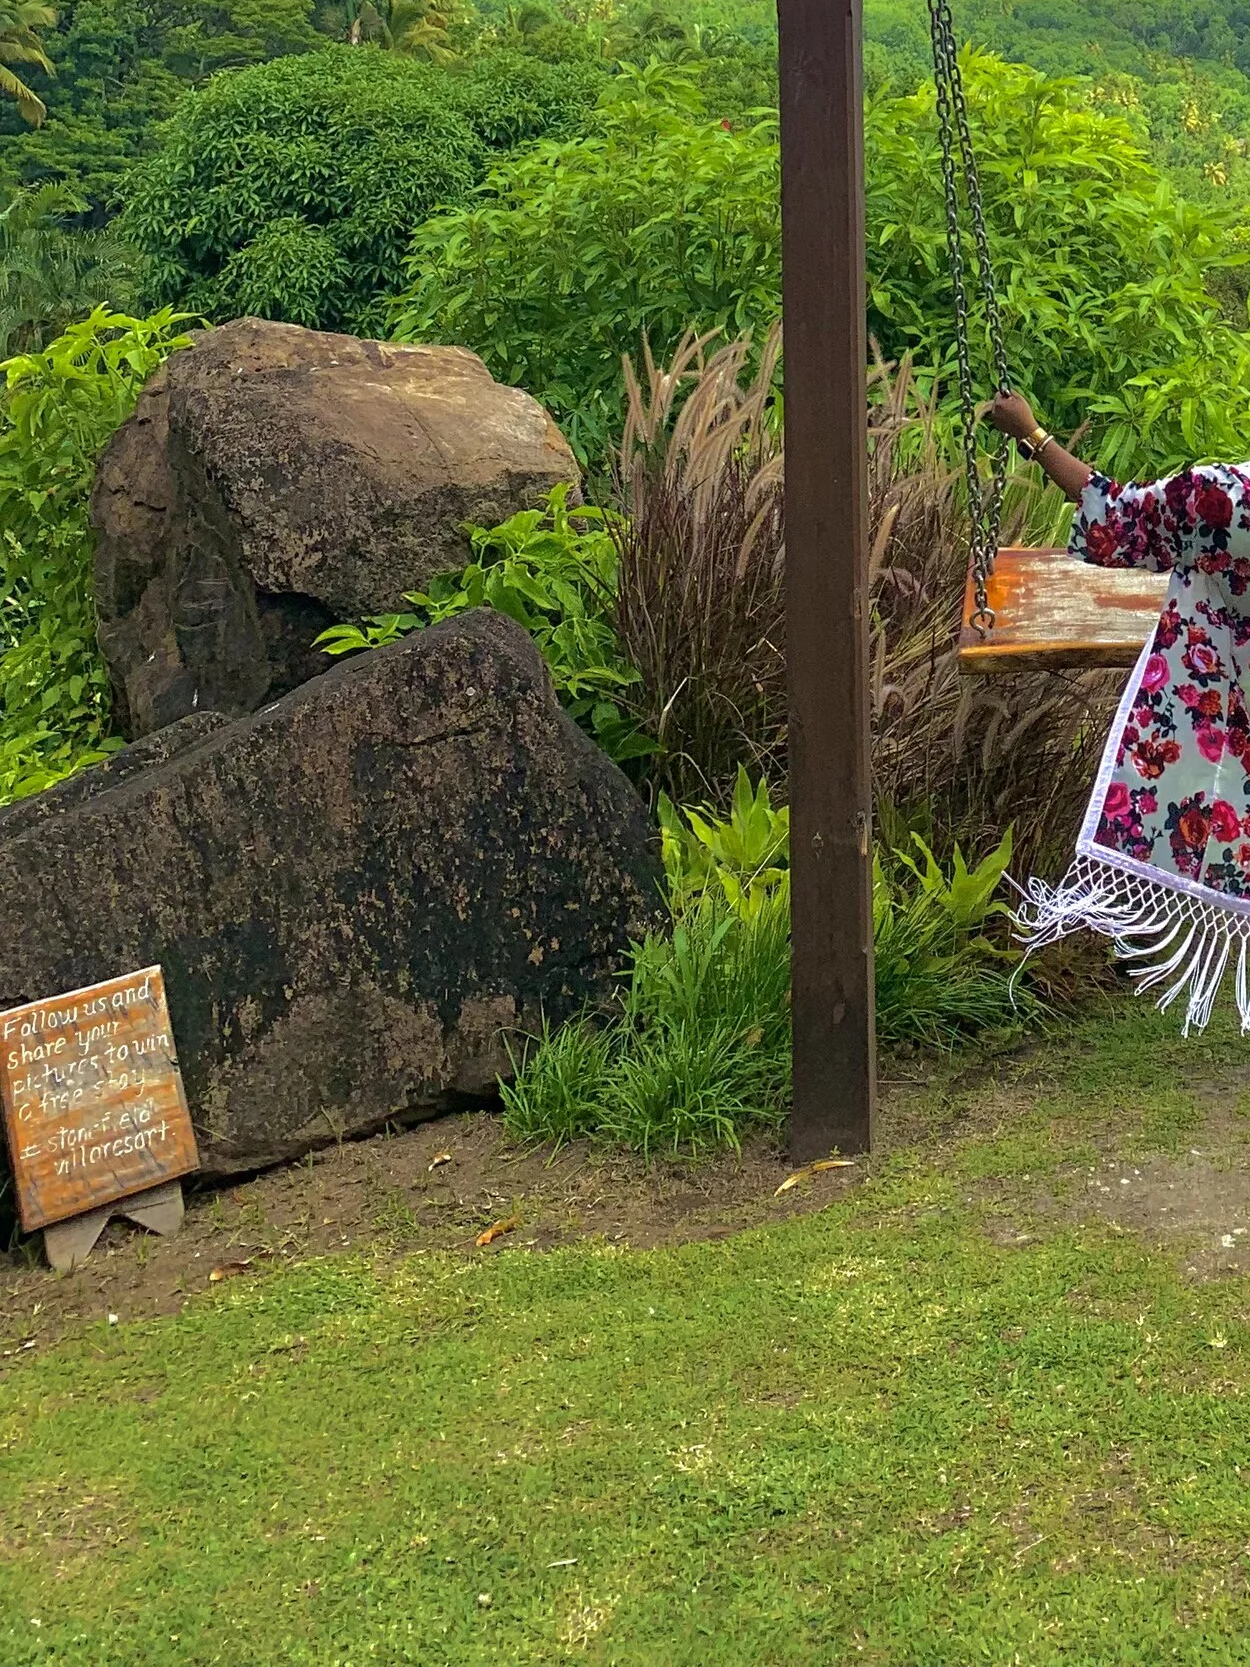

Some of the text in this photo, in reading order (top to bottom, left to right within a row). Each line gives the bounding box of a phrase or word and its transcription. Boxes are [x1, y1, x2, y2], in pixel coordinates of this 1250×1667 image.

[3, 975, 150, 1040] Follow us and
[7, 1021, 120, 1070] share your
[13, 1034, 170, 1107] pictures to win
[39, 1088, 83, 1114] free
[94, 1069, 146, 1098] stay
